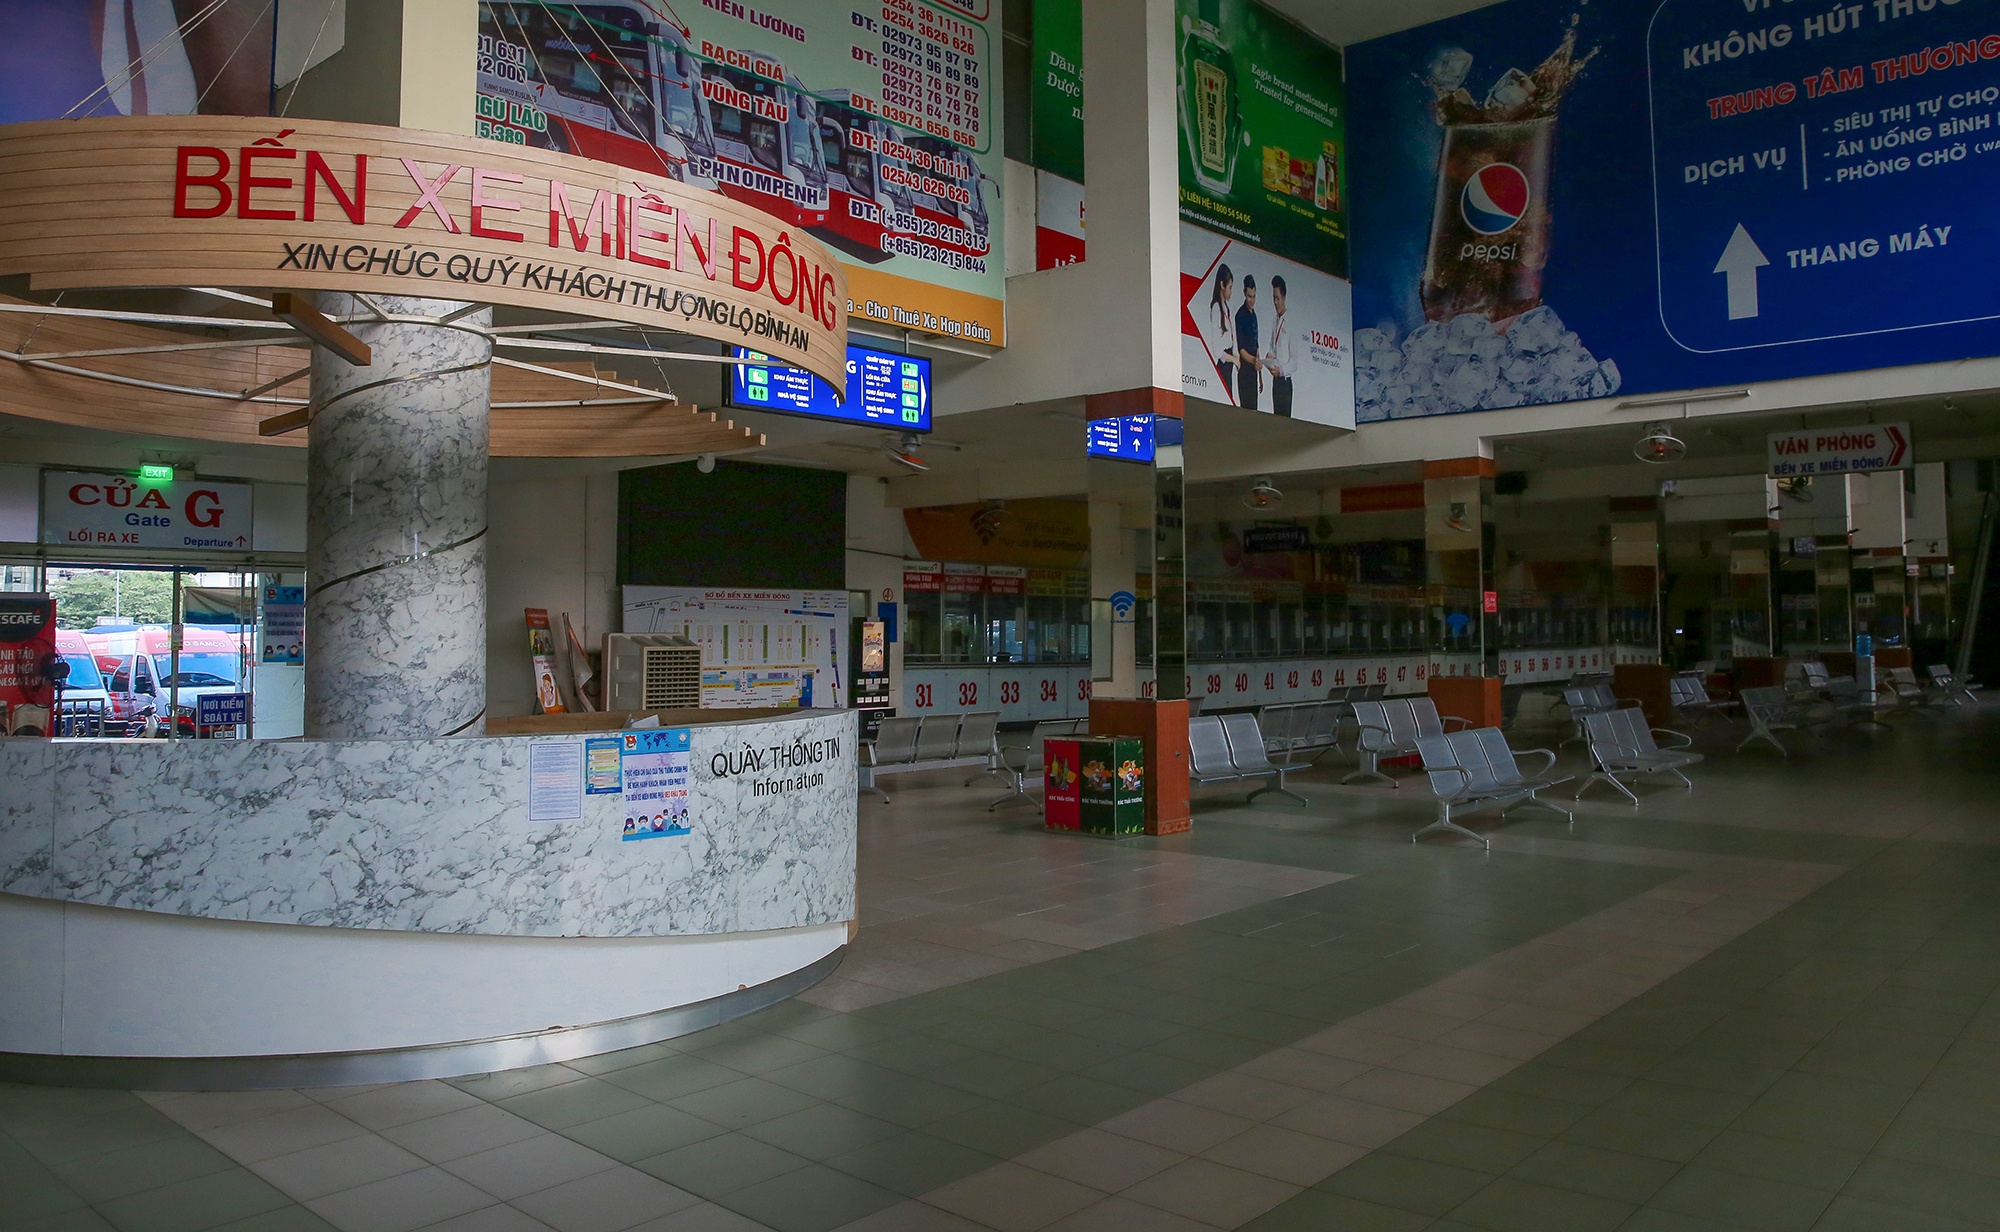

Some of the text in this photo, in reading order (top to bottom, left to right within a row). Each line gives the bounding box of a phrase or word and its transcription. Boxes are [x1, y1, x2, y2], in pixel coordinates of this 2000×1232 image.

[751, 9, 805, 42] LƯƠNG
[883, 7, 975, 56] 0254 3626 626
[918, 7, 973, 40] 36 11111
[1683, 3, 1864, 69] KHÔNG HÚT
[852, 12, 979, 73] ĐT: 02973 95 97 97
[702, 41, 784, 82] RẠCH GIÁ
[852, 46, 979, 104] ĐT: 02973 76 67 67
[883, 41, 979, 89] 02973 96 89 89
[1049, 51, 1076, 75] Dầu
[1707, 34, 2000, 120] TRUNG TÂM THƯƠNG
[500, 84, 515, 96] SAMCO
[883, 73, 979, 119] 02973 76 78 78
[1047, 71, 1080, 98] Được
[1252, 63, 1273, 82] Eagle
[1273, 75, 1294, 94] brand
[1295, 89, 1329, 113] medicated
[510, 102, 547, 132] LÃO
[701, 81, 788, 122] VŨNG TÀU
[883, 88, 979, 133] 02973 64 78 78
[1254, 79, 1334, 128] Trusted for generations
[1834, 95, 1943, 134] SIÊU THỊ TỰ
[852, 94, 976, 148] ĐT: 03973 656 656
[1836, 113, 1990, 159] ĂN UỐNG BÌNH
[851, 130, 968, 180] ĐT: 0254 36 11111
[1684, 147, 1788, 185] DỊCH VỤ
[1837, 142, 1968, 183] PHÒNG CHỜ
[700, 158, 818, 206] PHNOMPENH
[882, 165, 970, 205] 02543 626 626
[1187, 191, 1201, 205] LIÊN
[1213, 202, 1228, 215] 1800
[1228, 207, 1236, 218] 54
[1236, 210, 1244, 221] 54
[1244, 214, 1251, 224] 05
[174, 128, 836, 332] BẾN XE MIỀN ĐÔNG
[851, 200, 986, 251] ĐT: (+855)23 215 313
[881, 233, 986, 274] (+855)23 215 844
[1460, 242, 1517, 263] pepsi
[1786, 223, 1952, 269] THANG MÁY
[278, 242, 809, 352] XIN CHÚC QUÝ KHÁCH THƯỢNG LỘ BÌNH AN
[866, 300, 889, 320] Cho
[892, 306, 920, 326] Thuê
[923, 312, 938, 329] Xe
[940, 316, 961, 337] Hợp
[964, 321, 991, 343] Đồng
[1311, 330, 1339, 350] 12.000
[1774, 432, 1876, 455] VĂN PHÒNG
[146, 468, 167, 478] EXIT
[1774, 456, 1884, 475] BẾN XE MIỀN ĐÔNG
[69, 478, 225, 529] CỬA G
[69, 527, 140, 544] LỐI RA XE
[125, 513, 171, 528] Gate
[184, 537, 234, 549] Departure
[1208, 674, 1221, 694] 39
[1235, 673, 1248, 692] 40
[1264, 672, 1275, 690] 41
[1288, 671, 1299, 688] 42
[1311, 669, 1322, 687] 43
[1335, 668, 1345, 686] 44
[1357, 667, 1367, 684] 45
[1377, 666, 1387, 683] 46
[1397, 665, 1407, 682] 47
[1416, 665, 1426, 681] 48
[203, 696, 244, 710] NƠI KIỂM
[916, 683, 933, 708] 31
[959, 682, 978, 706] 32
[1001, 681, 1020, 704] 33
[1041, 679, 1058, 702] 34
[204, 711, 243, 723] SOÁT VÉ
[711, 736, 840, 778] QUẦY THÔNG TIN
